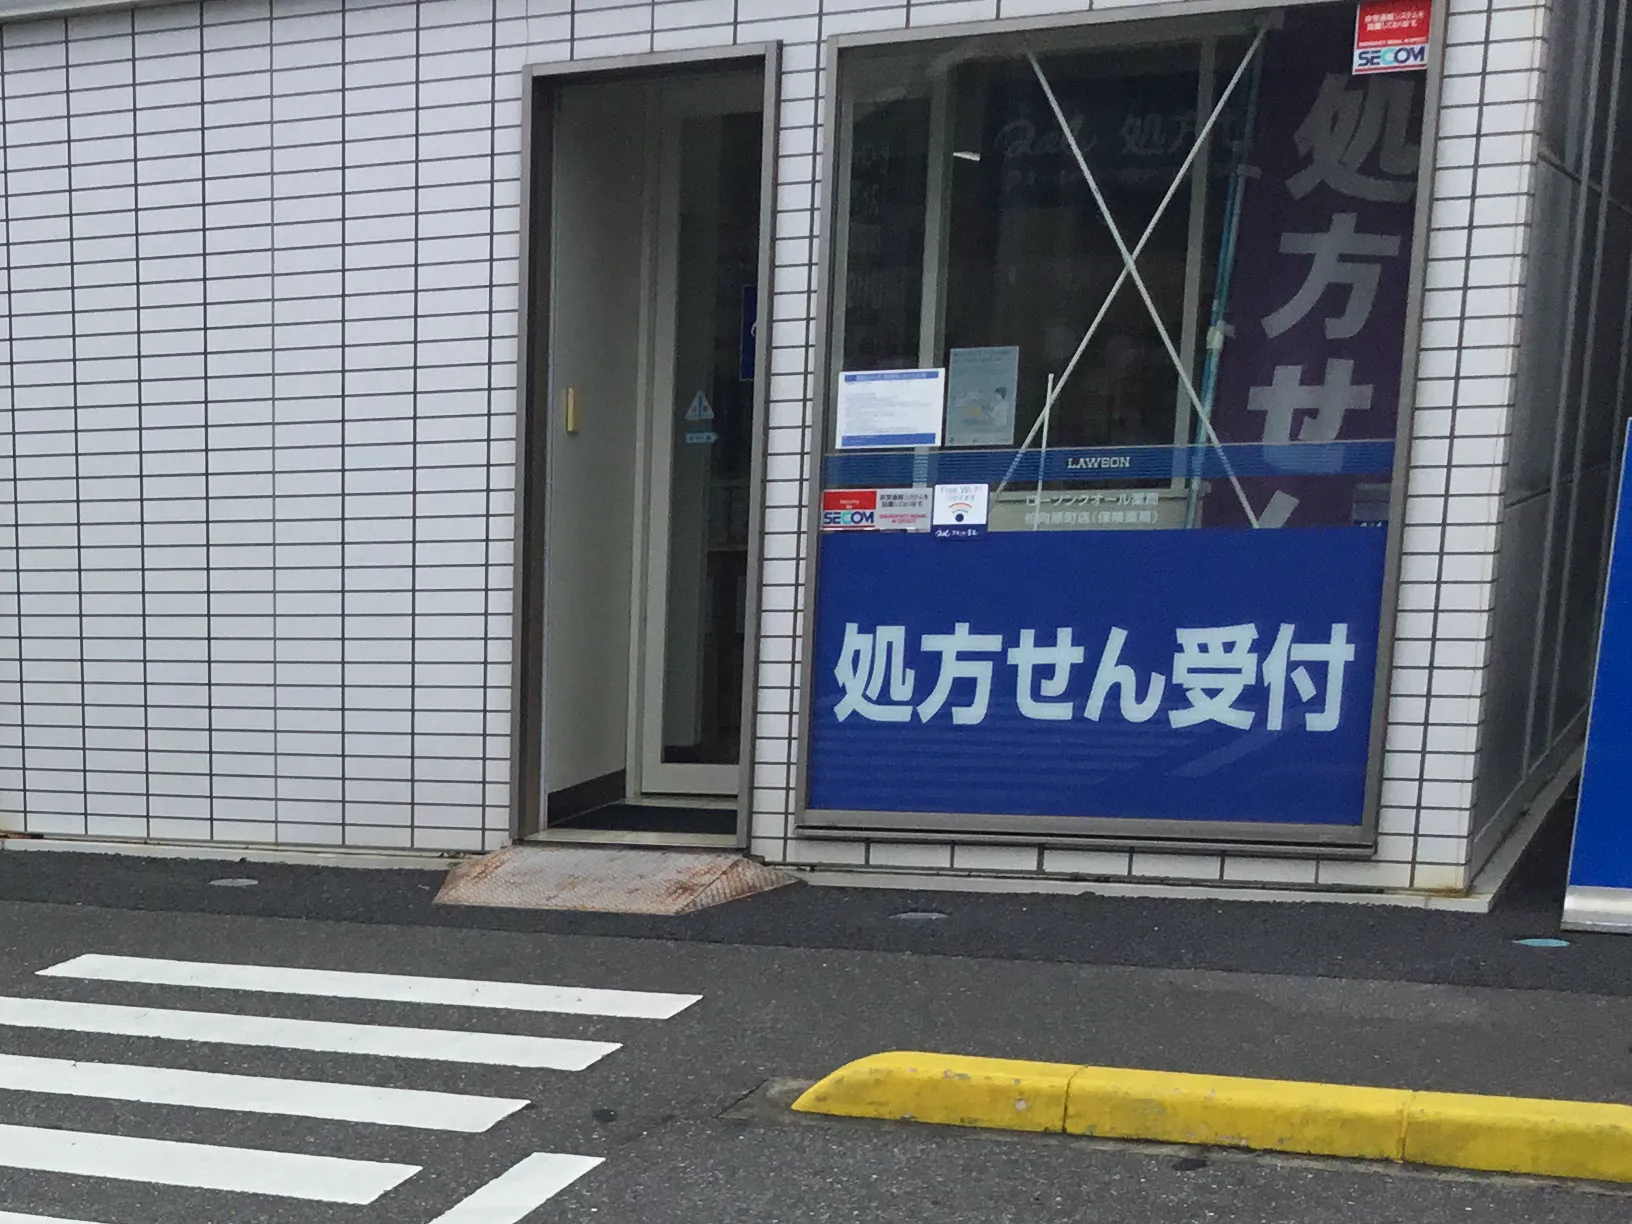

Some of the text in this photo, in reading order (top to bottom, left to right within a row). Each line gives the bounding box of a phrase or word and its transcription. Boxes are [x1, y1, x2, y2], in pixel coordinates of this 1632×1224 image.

[1358, 46, 1425, 66] SECOM
[1248, 72, 1418, 528] 処方せ
[1068, 457, 1130, 469] LAWSON
[824, 511, 874, 524] SECOM
[833, 621, 1356, 734] 処方せん受付
